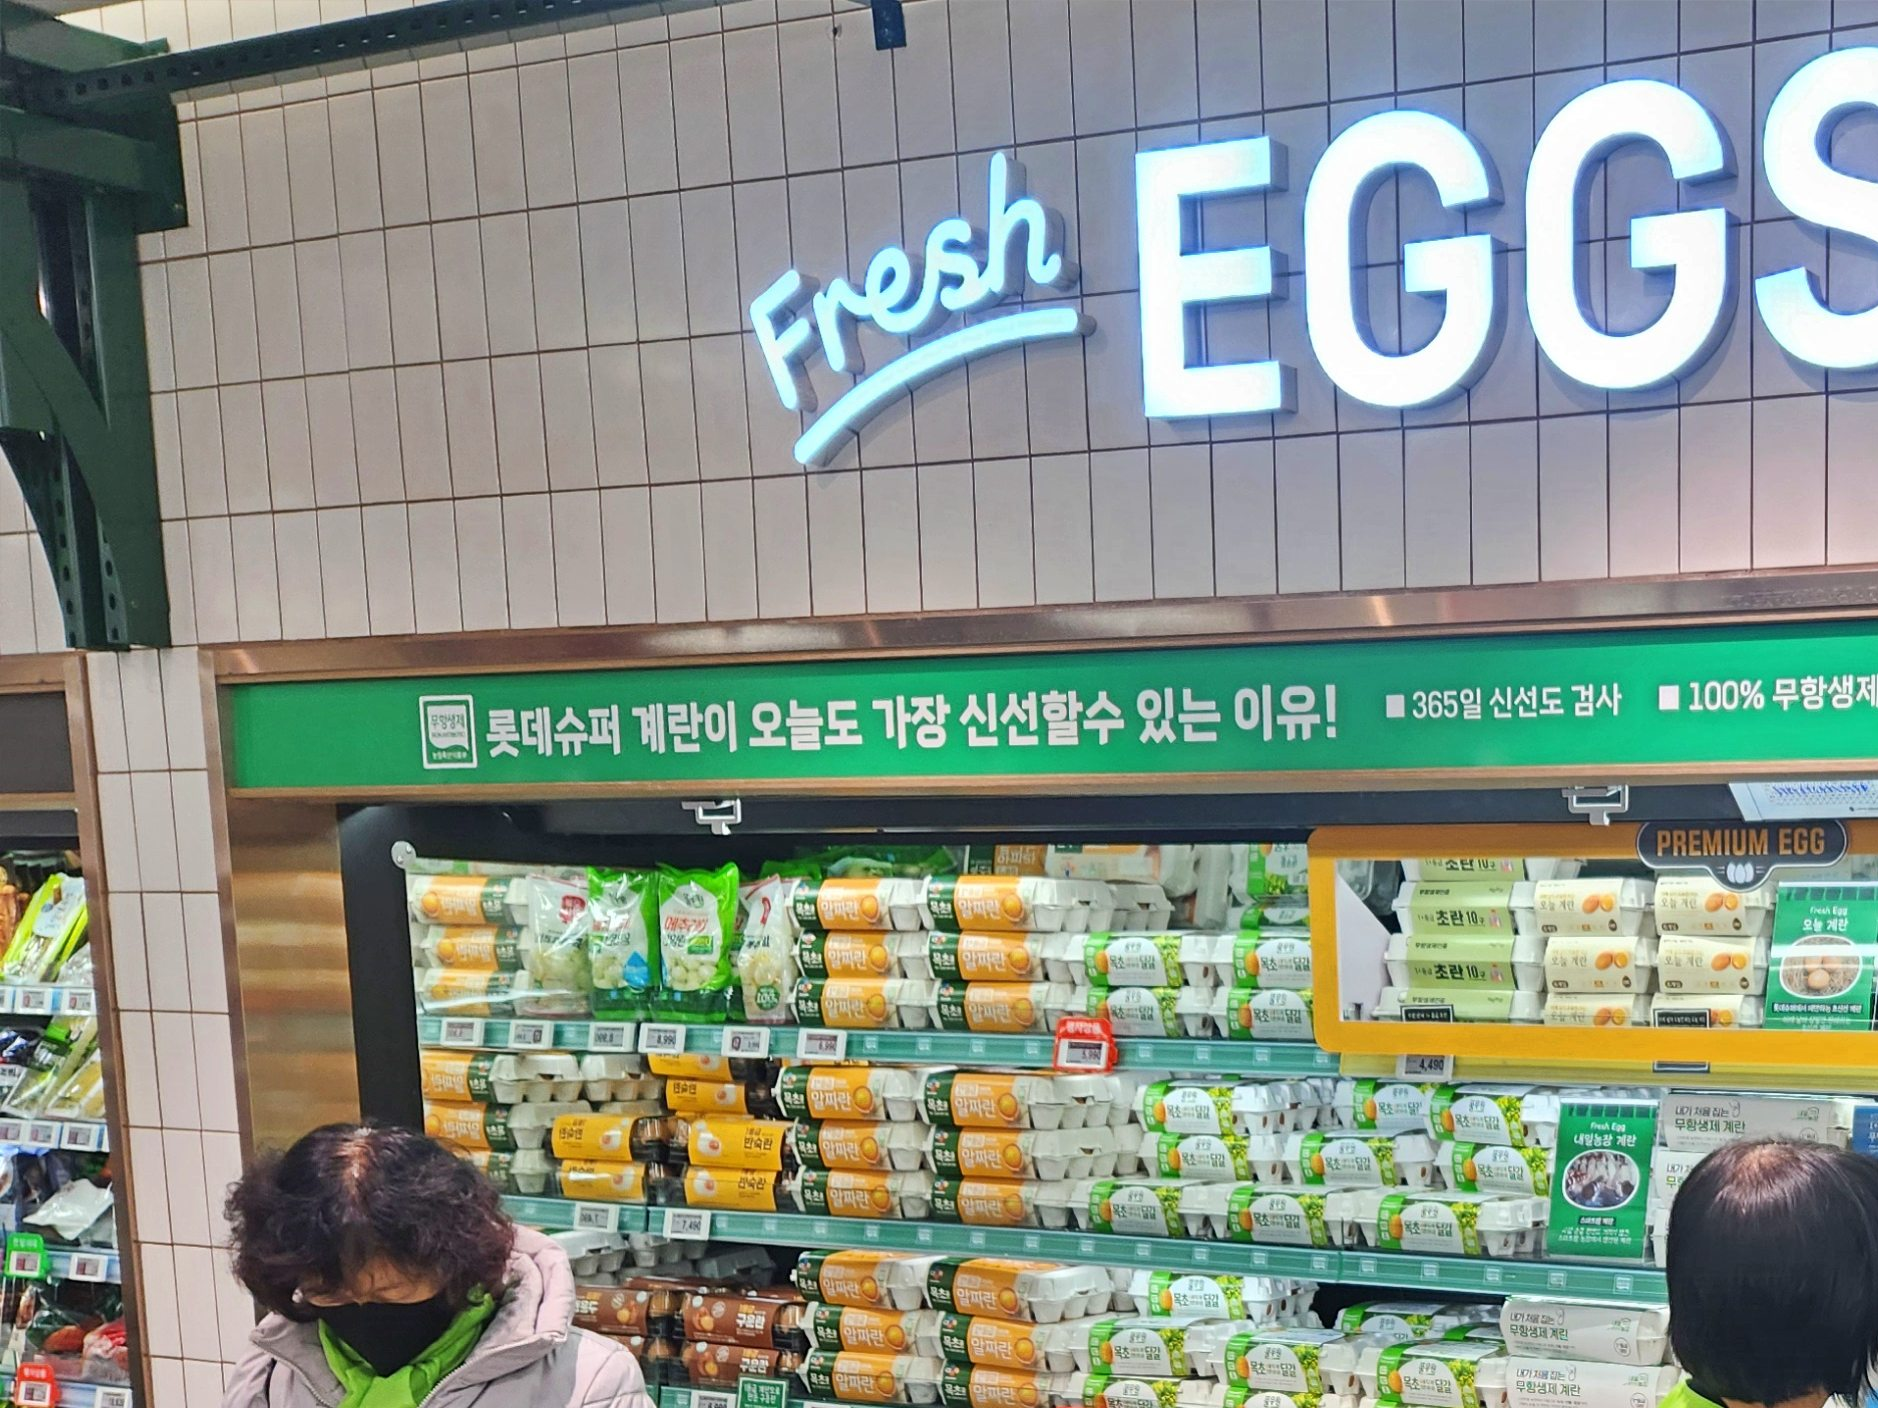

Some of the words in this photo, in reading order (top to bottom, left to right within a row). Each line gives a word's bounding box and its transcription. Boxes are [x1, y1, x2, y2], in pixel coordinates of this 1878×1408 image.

[750, 152, 1062, 413] Fresh
[1412, 689, 1483, 721] 365일
[1489, 687, 1564, 718] 신선도
[1571, 685, 1621, 716] 검사
[1689, 679, 1764, 711] 100%
[486, 704, 621, 758] 롯데슈퍼
[632, 701, 738, 754] 계란이
[749, 696, 863, 751] 오늘도
[872, 695, 950, 751] 가장
[959, 688, 1124, 750] 신선할수
[1135, 686, 1218, 743] 있는
[1234, 684, 1337, 742] 이유!
[1657, 829, 1768, 857] PREMIUM
[1778, 827, 1825, 855] EGG
[1436, 910, 1464, 927] 초란
[1832, 906, 1848, 917] Egg
[1803, 920, 1821, 932] 오늘
[1827, 919, 1848, 932] 계란
[1435, 964, 1464, 980] 초란
[1419, 1059, 1444, 1071] 4,490
[1611, 1122, 1626, 1133] Egg
[1675, 1118, 1720, 1132] 무항생제
[1723, 1120, 1745, 1133] 계란
[1617, 1134, 1637, 1147] 계란
[1510, 1324, 1548, 1339] 무항생제
[1550, 1328, 1568, 1341] 계란
[1516, 1380, 1557, 1396] 무항생제
[1560, 1384, 1580, 1397] 계란
